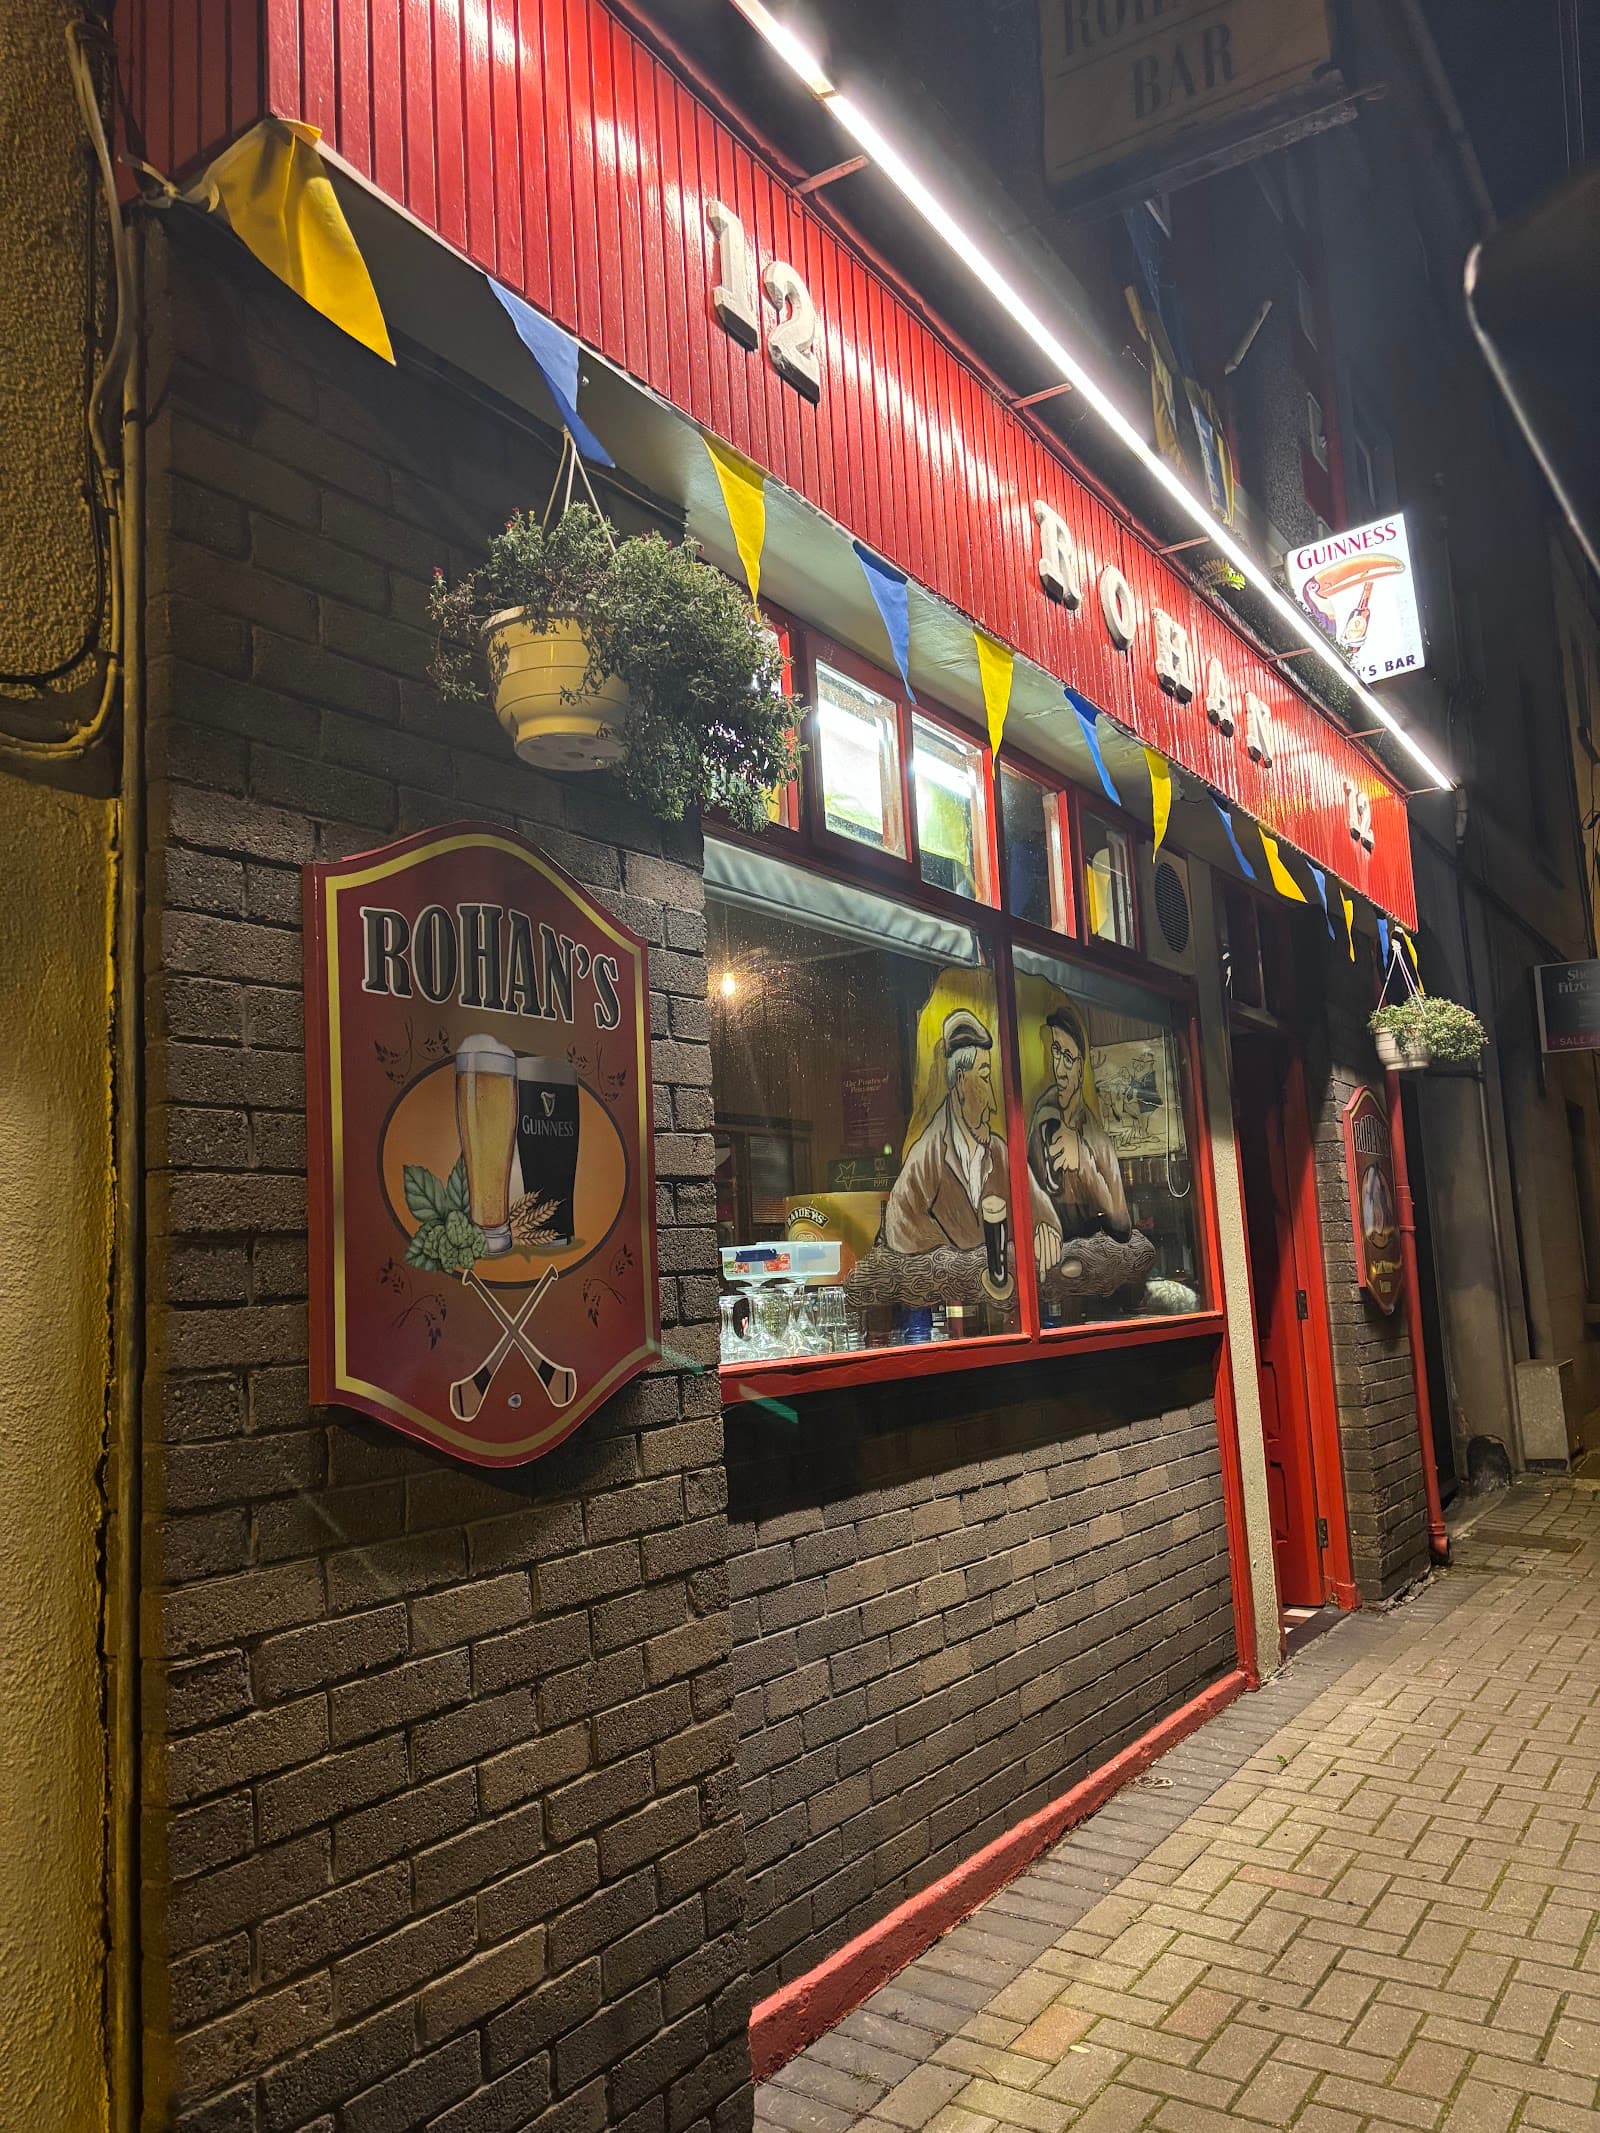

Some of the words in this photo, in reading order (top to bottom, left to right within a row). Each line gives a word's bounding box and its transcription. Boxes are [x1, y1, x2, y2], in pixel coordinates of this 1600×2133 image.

[1131, 23, 1236, 120] BAR
[705, 199, 820, 404] 12
[1296, 522, 1398, 570] GUINNESS
[1033, 499, 1274, 769] ROHAN
[1384, 654, 1416, 672] BAR
[359, 902, 622, 1031] ROHAN'S
[522, 1114, 575, 1137] GUINNESS
